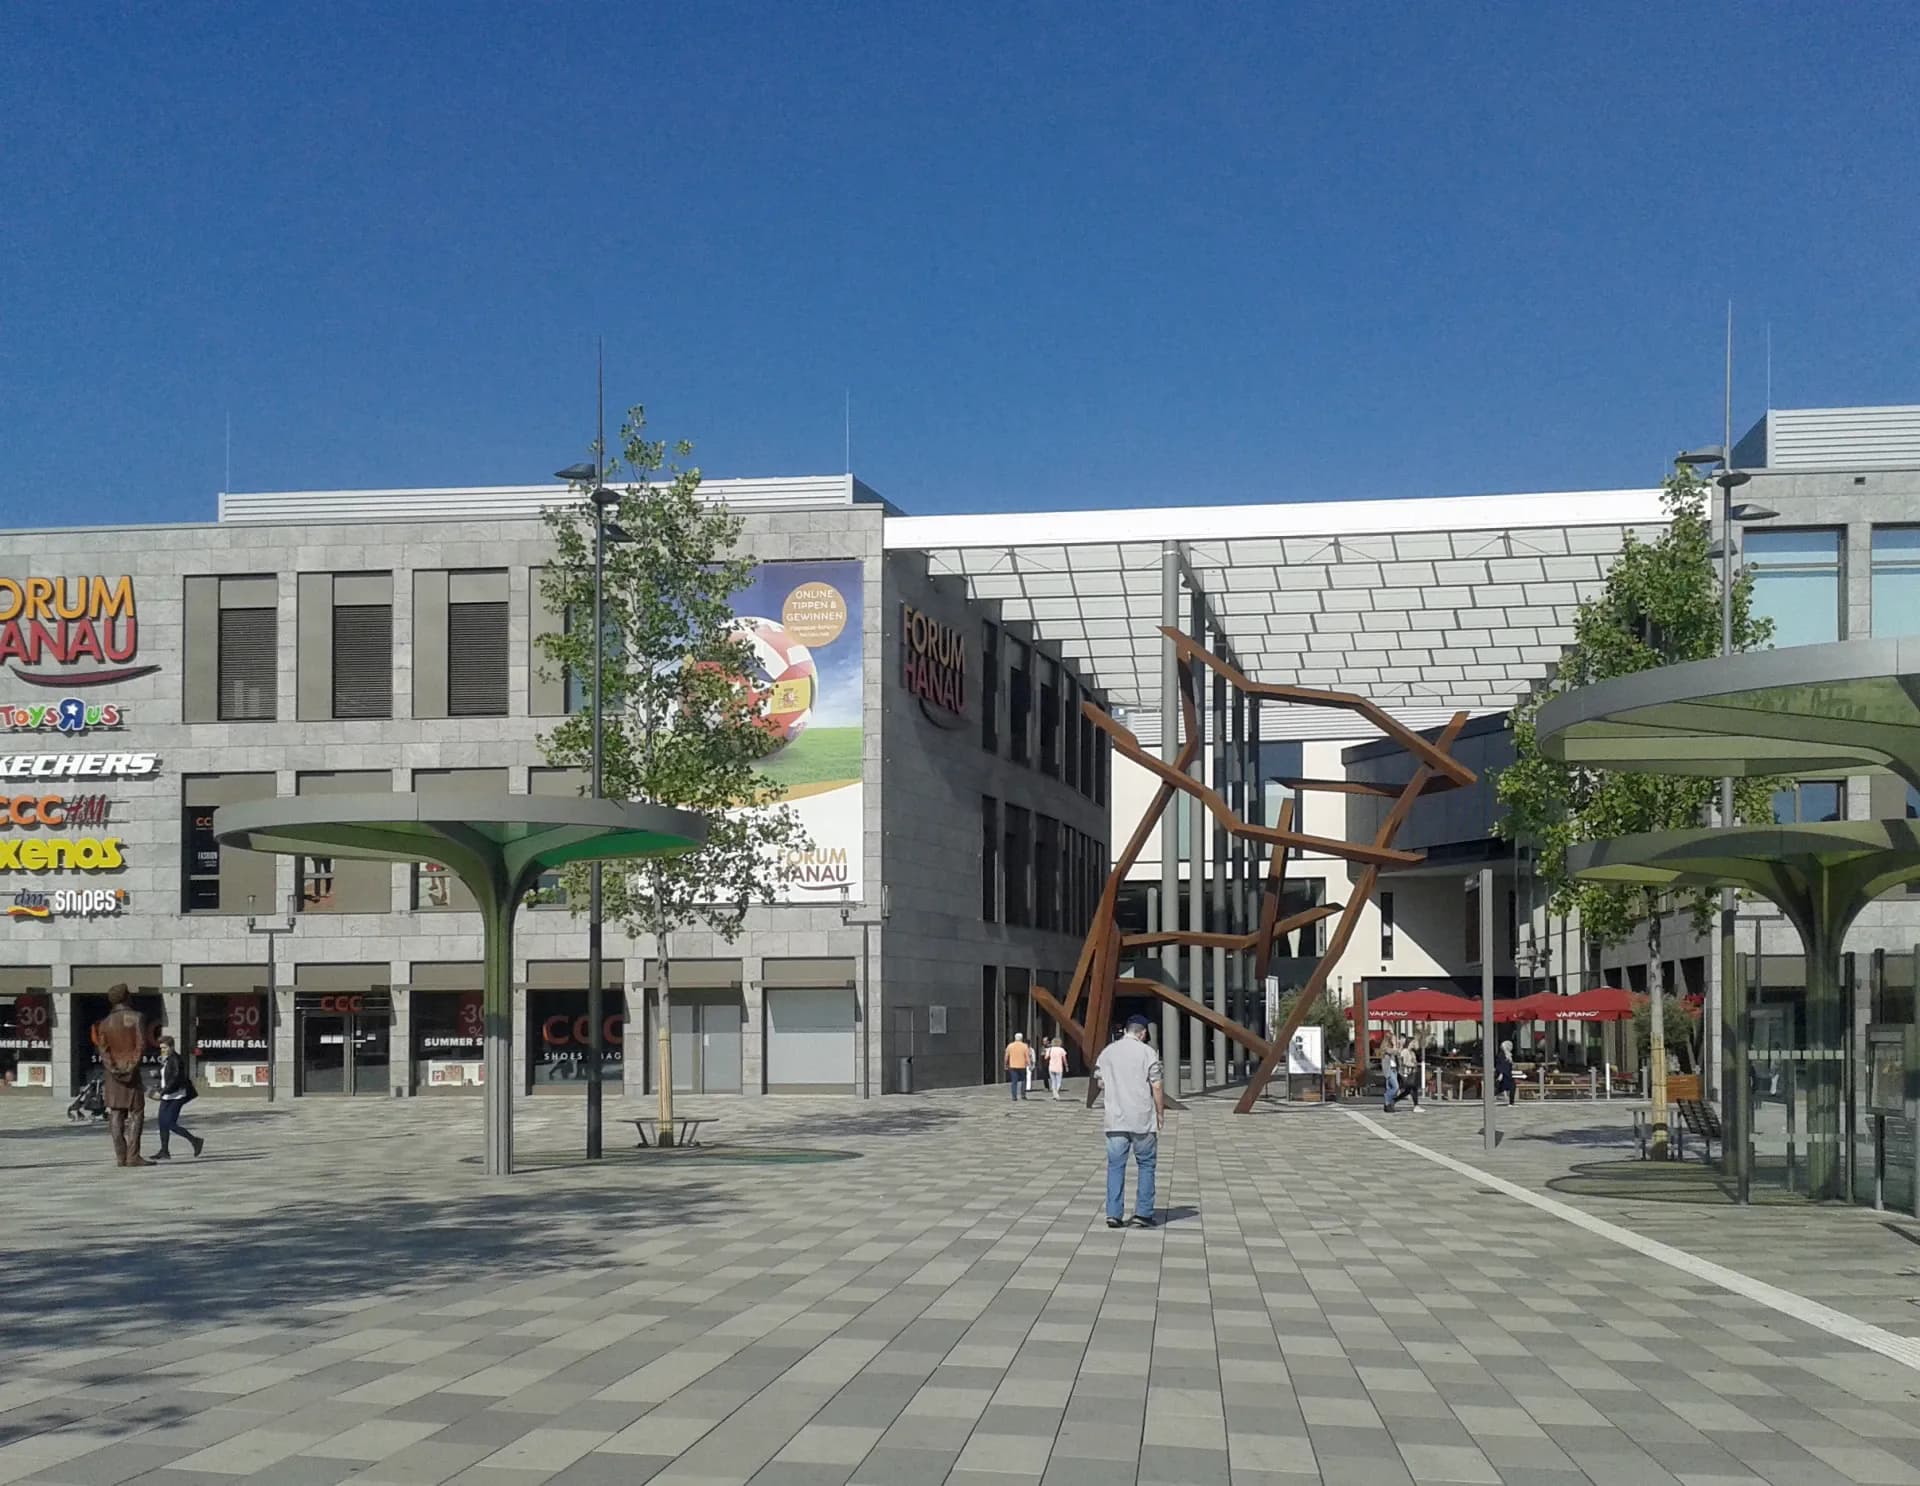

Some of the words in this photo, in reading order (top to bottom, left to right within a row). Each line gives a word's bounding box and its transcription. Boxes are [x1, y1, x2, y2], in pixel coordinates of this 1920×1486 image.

[795, 590, 833, 600] ONLINE
[792, 601, 828, 610] TIPPEN
[786, 611, 843, 622] GEWINNEN
[0, 618, 138, 664] ANAU
[904, 604, 966, 674] FORUM
[904, 652, 967, 714] HANAU
[777, 848, 847, 865] FORUM
[777, 864, 847, 882] HANAU
[55, 888, 116, 916] snipes
[31, 1040, 51, 1049] SAL
[197, 1039, 245, 1049] SUMMER
[247, 1039, 268, 1049] SAL
[424, 1037, 474, 1047] SUMMER
[543, 1052, 583, 1061] SHOES
